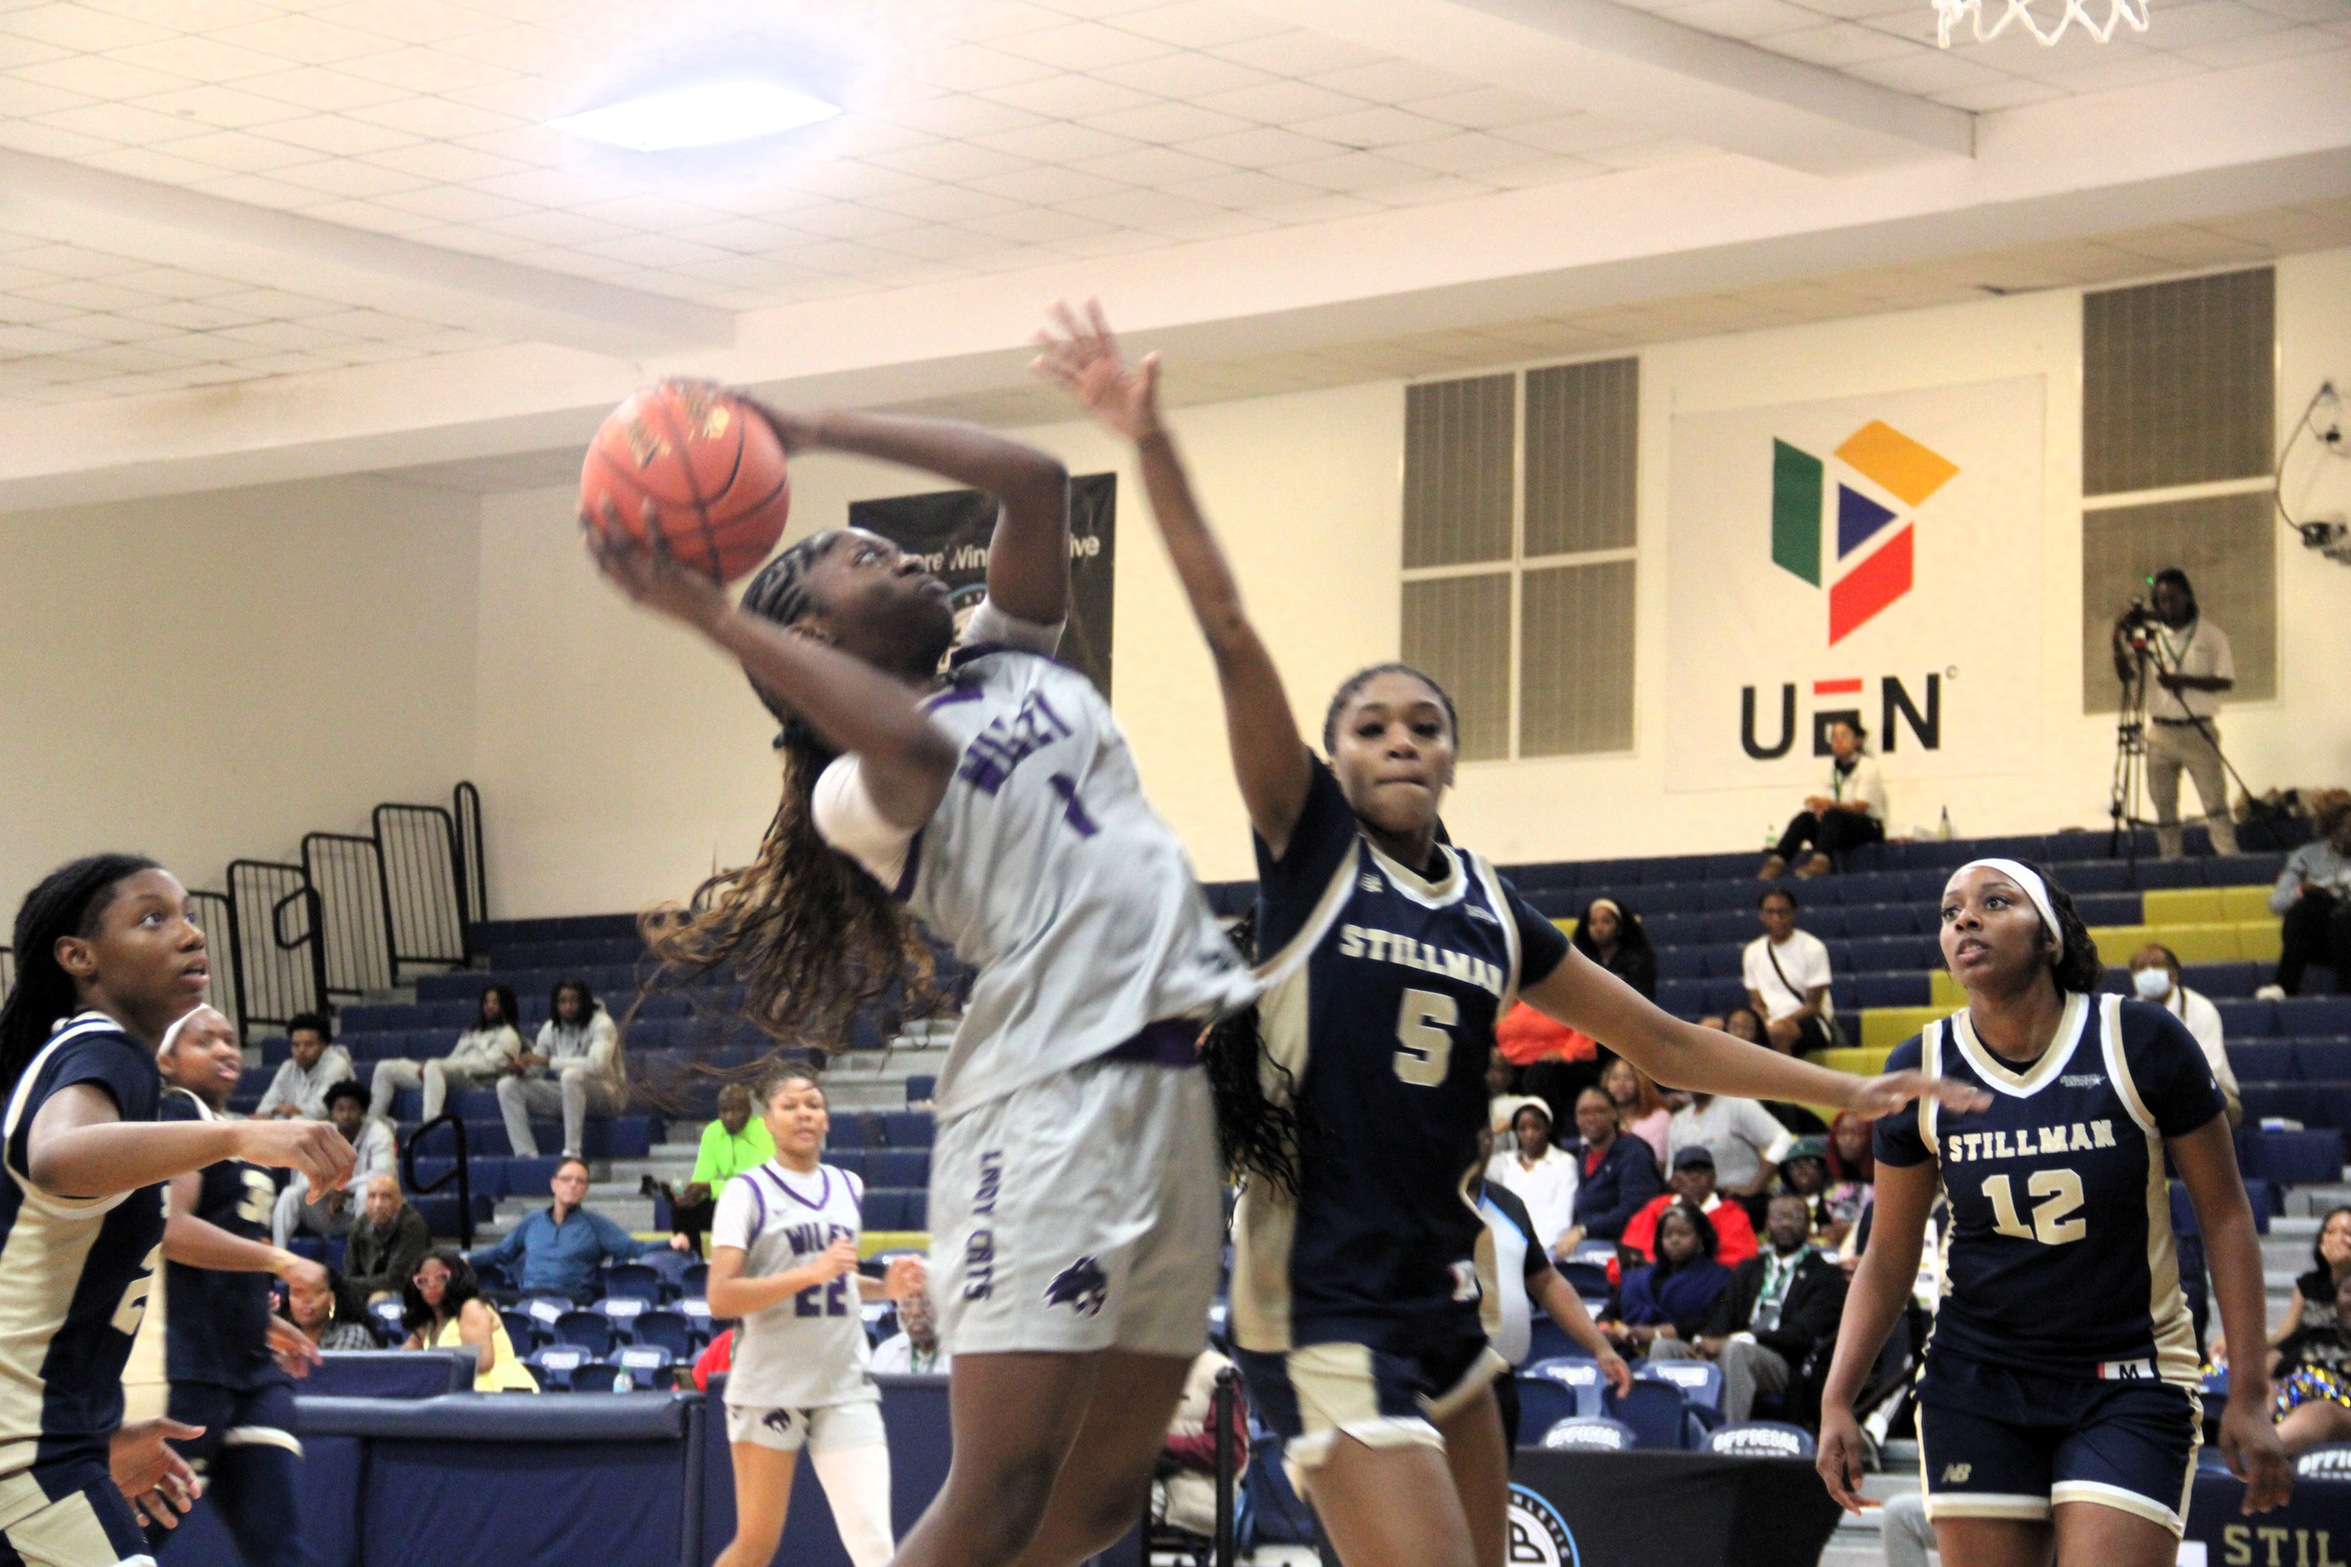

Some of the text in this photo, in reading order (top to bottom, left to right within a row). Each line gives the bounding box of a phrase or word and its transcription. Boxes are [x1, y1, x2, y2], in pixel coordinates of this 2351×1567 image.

[1049, 772, 1099, 839] 1
[1393, 987, 1459, 1088] 5
[1949, 1119, 2117, 1162] STILLMAN
[1981, 1168, 2087, 1246] 12
[2298, 1450, 2351, 1475] OFFI
